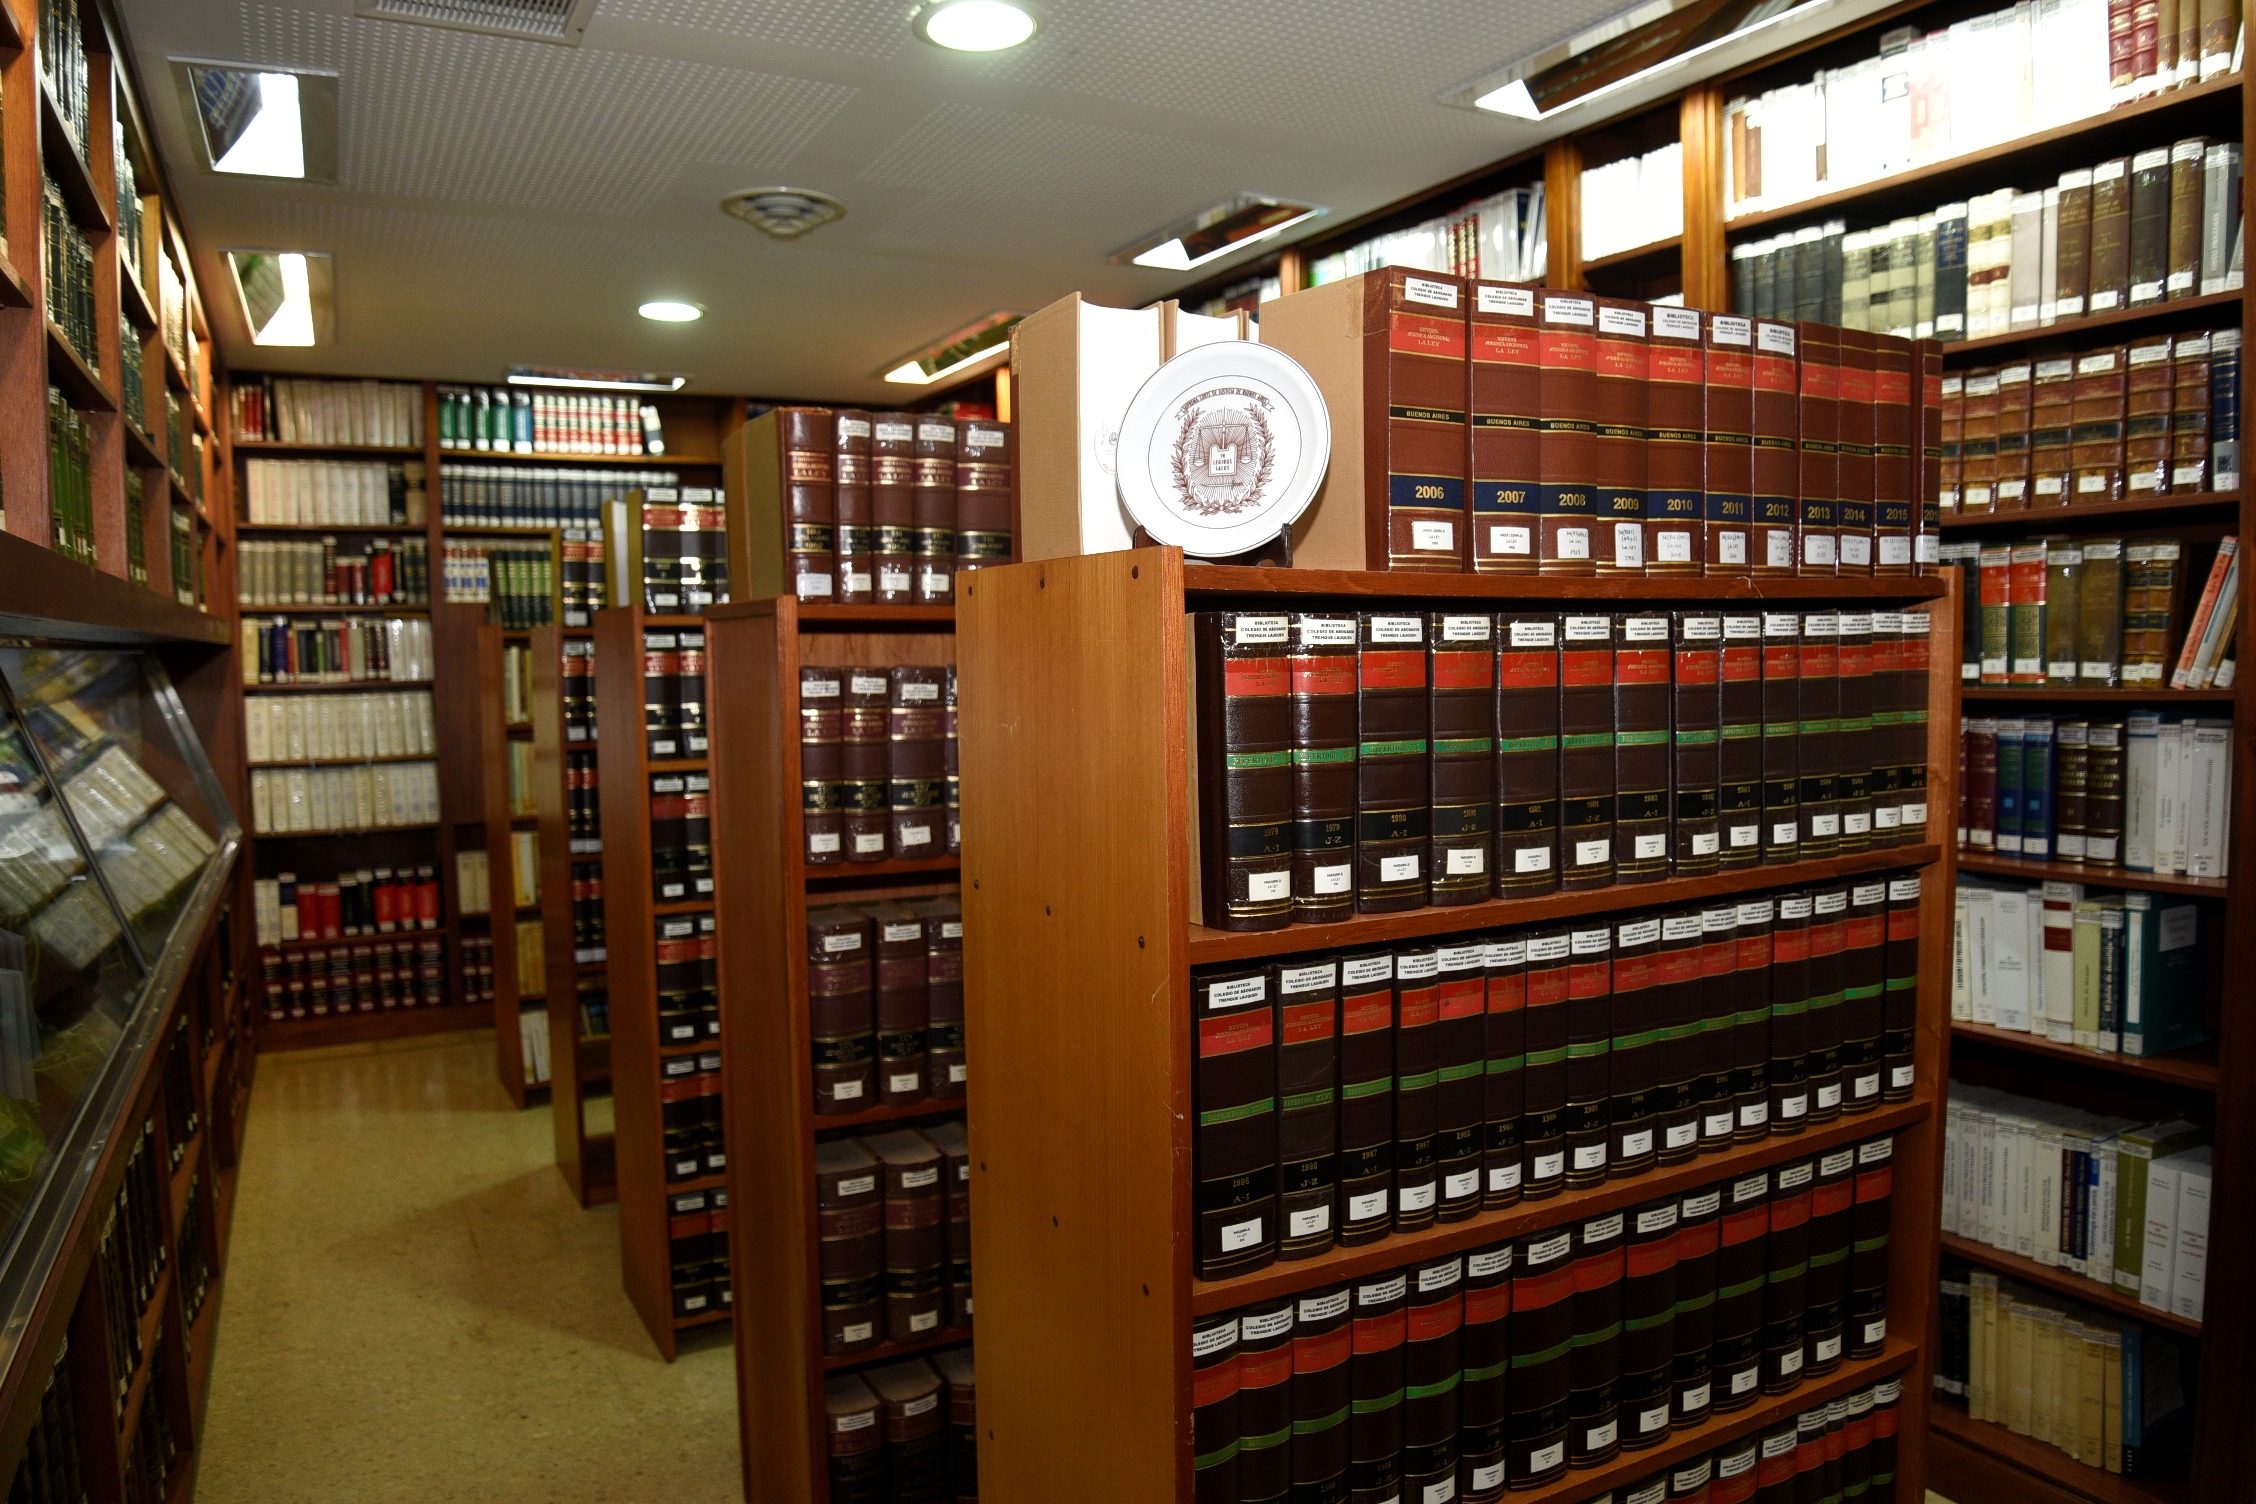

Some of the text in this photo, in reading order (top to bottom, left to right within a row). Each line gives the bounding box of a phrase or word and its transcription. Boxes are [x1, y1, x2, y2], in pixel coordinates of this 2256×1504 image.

[1415, 486, 1444, 499] 2006
[1497, 491, 1525, 503] 2007
[1559, 494, 1586, 506] 2008
[1614, 498, 1639, 510] 2009
[1667, 499, 1692, 511] 2010
[1722, 502, 1744, 515] 2011
[1767, 504, 1789, 517] 2012
[1808, 506, 1830, 520] 2013
[1886, 508, 1907, 520] 2015
[1844, 508, 1865, 521] 2014
[1264, 828, 1278, 836] 1979
[1325, 824, 1340, 832] 1979
[1325, 836, 1342, 844] J-Z
[1264, 844, 1280, 853] A-I
[1415, 1140, 1430, 1150] 1987
[1362, 1149, 1377, 1160] 1987
[1416, 1155, 1430, 1164] J-Z
[1301, 1162, 1318, 1172] 1986
[1362, 1166, 1377, 1175] A-I
[1233, 1177, 1249, 1188] 1986
[1301, 1178, 1318, 1187] J-Z
[1233, 1193, 1250, 1203] A-I
[1260, 1314, 1283, 1323] BIBLIOTECA
[1274, 1315, 1292, 1325] ABOGADOS
[1202, 1328, 1226, 1339] BIBLIOTECA
[1216, 1329, 1235, 1341] ABOGADOS
